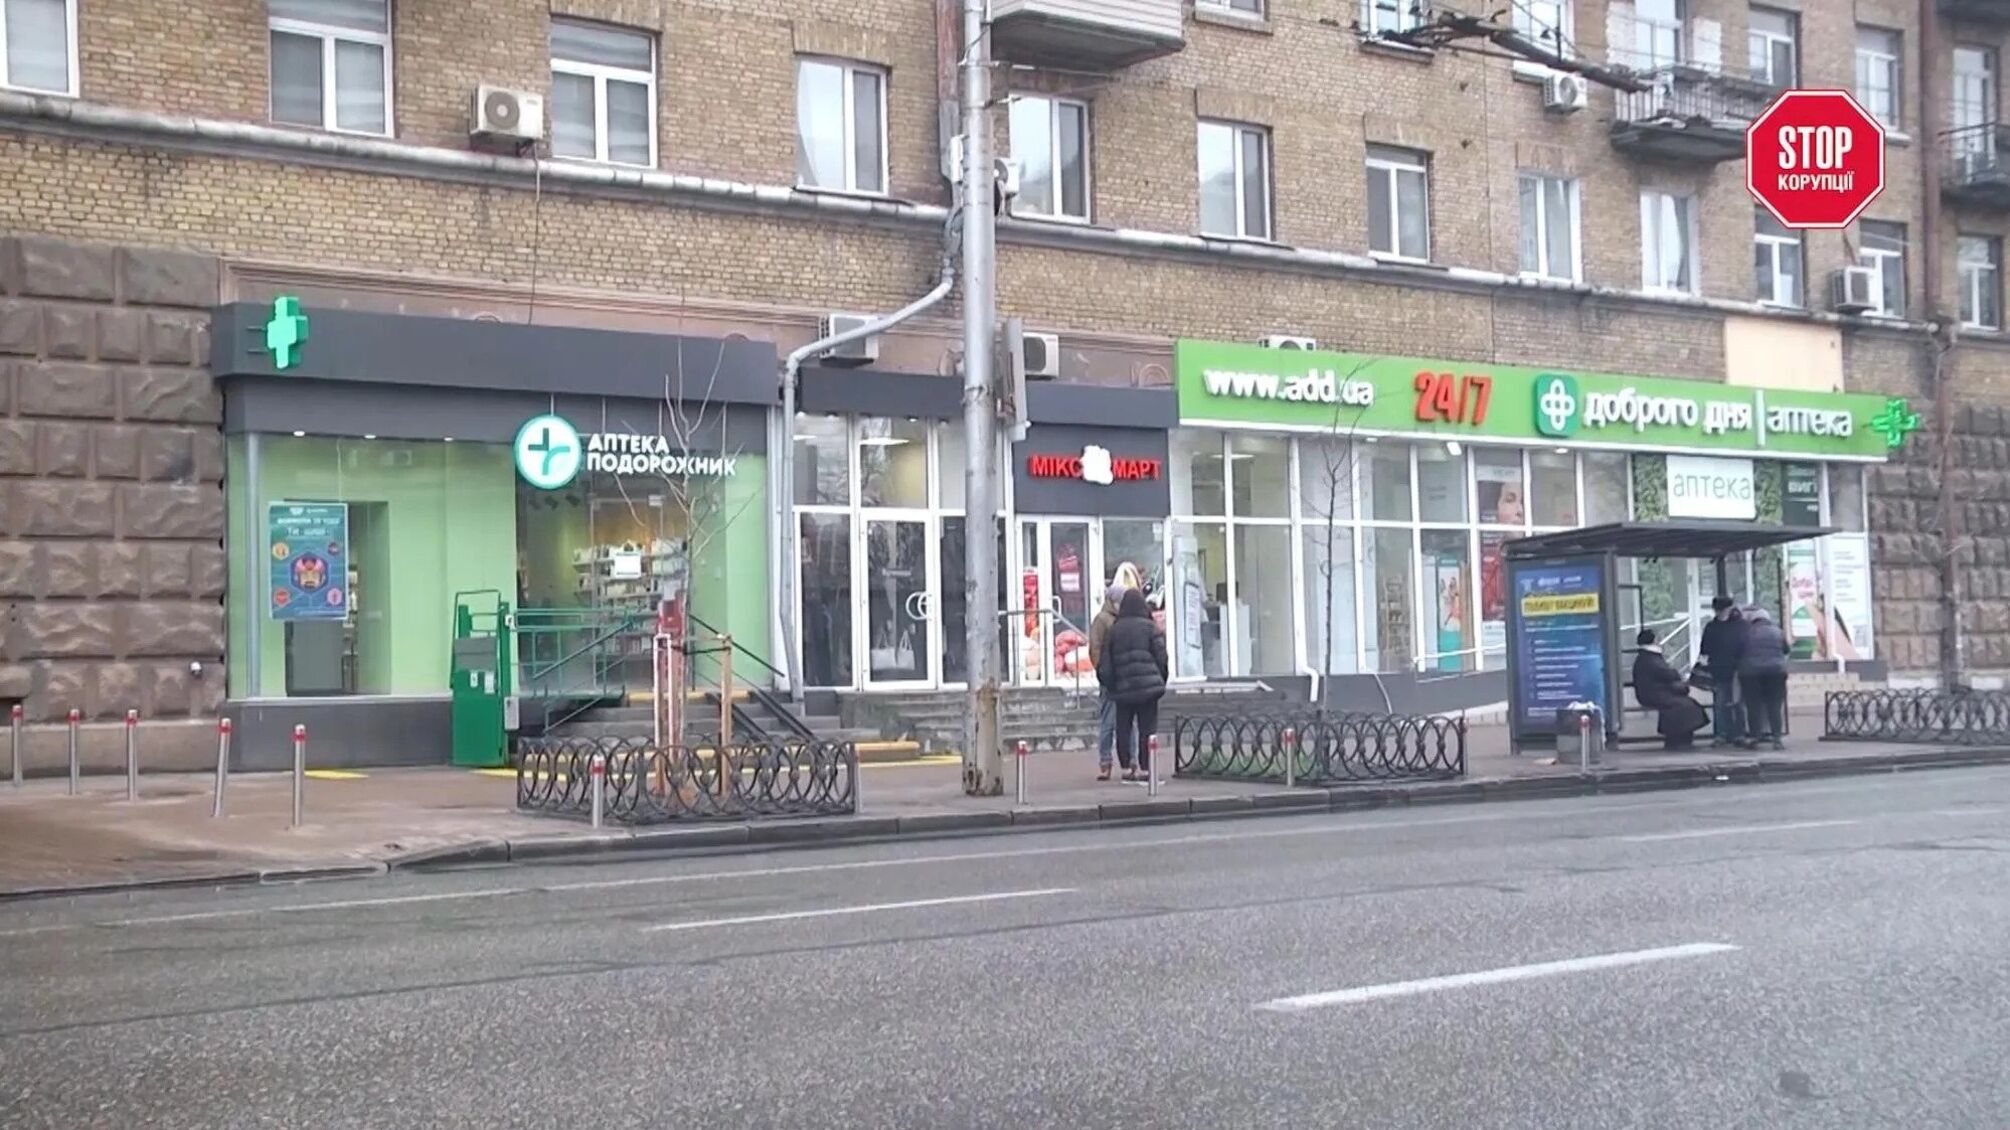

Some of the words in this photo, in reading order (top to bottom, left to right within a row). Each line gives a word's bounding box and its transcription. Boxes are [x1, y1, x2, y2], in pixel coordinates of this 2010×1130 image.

[1203, 368, 1374, 405] www.add.ua
[1414, 371, 1493, 425] 24/7
[1584, 387, 1699, 432] доброго
[1702, 400, 1752, 434] дня
[1766, 405, 1852, 437] аптека
[588, 433, 670, 454] АПТЕКА
[587, 452, 736, 476] ПОДОРОЖНИК
[1030, 454, 1083, 477] МІКС
[1112, 458, 1162, 480] МАРТ
[1673, 473, 1751, 499] аптека
